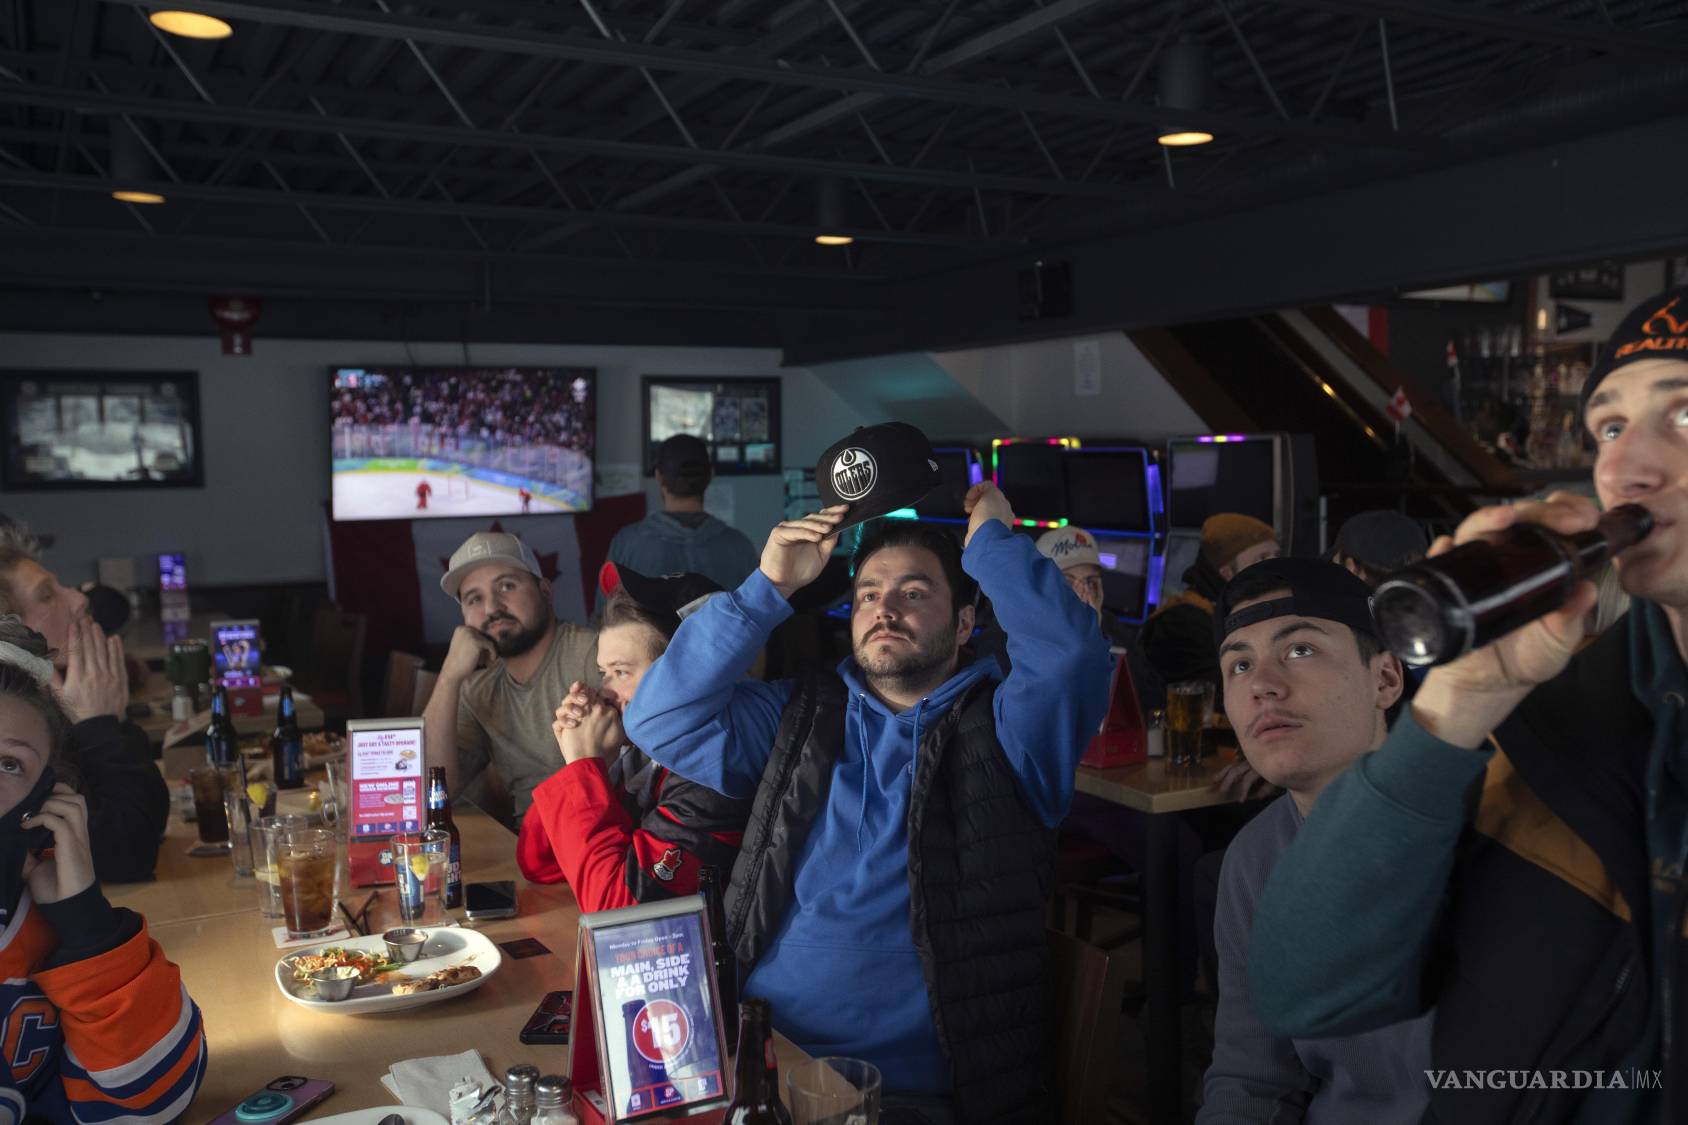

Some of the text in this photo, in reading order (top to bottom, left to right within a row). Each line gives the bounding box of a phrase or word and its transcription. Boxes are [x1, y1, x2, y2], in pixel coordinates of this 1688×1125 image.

[835, 460, 873, 495] OILERS
[610, 953, 690, 978] MAIN, SIDE
[643, 965, 690, 983] DRINK
[615, 975, 688, 1000] FOR ONLY
